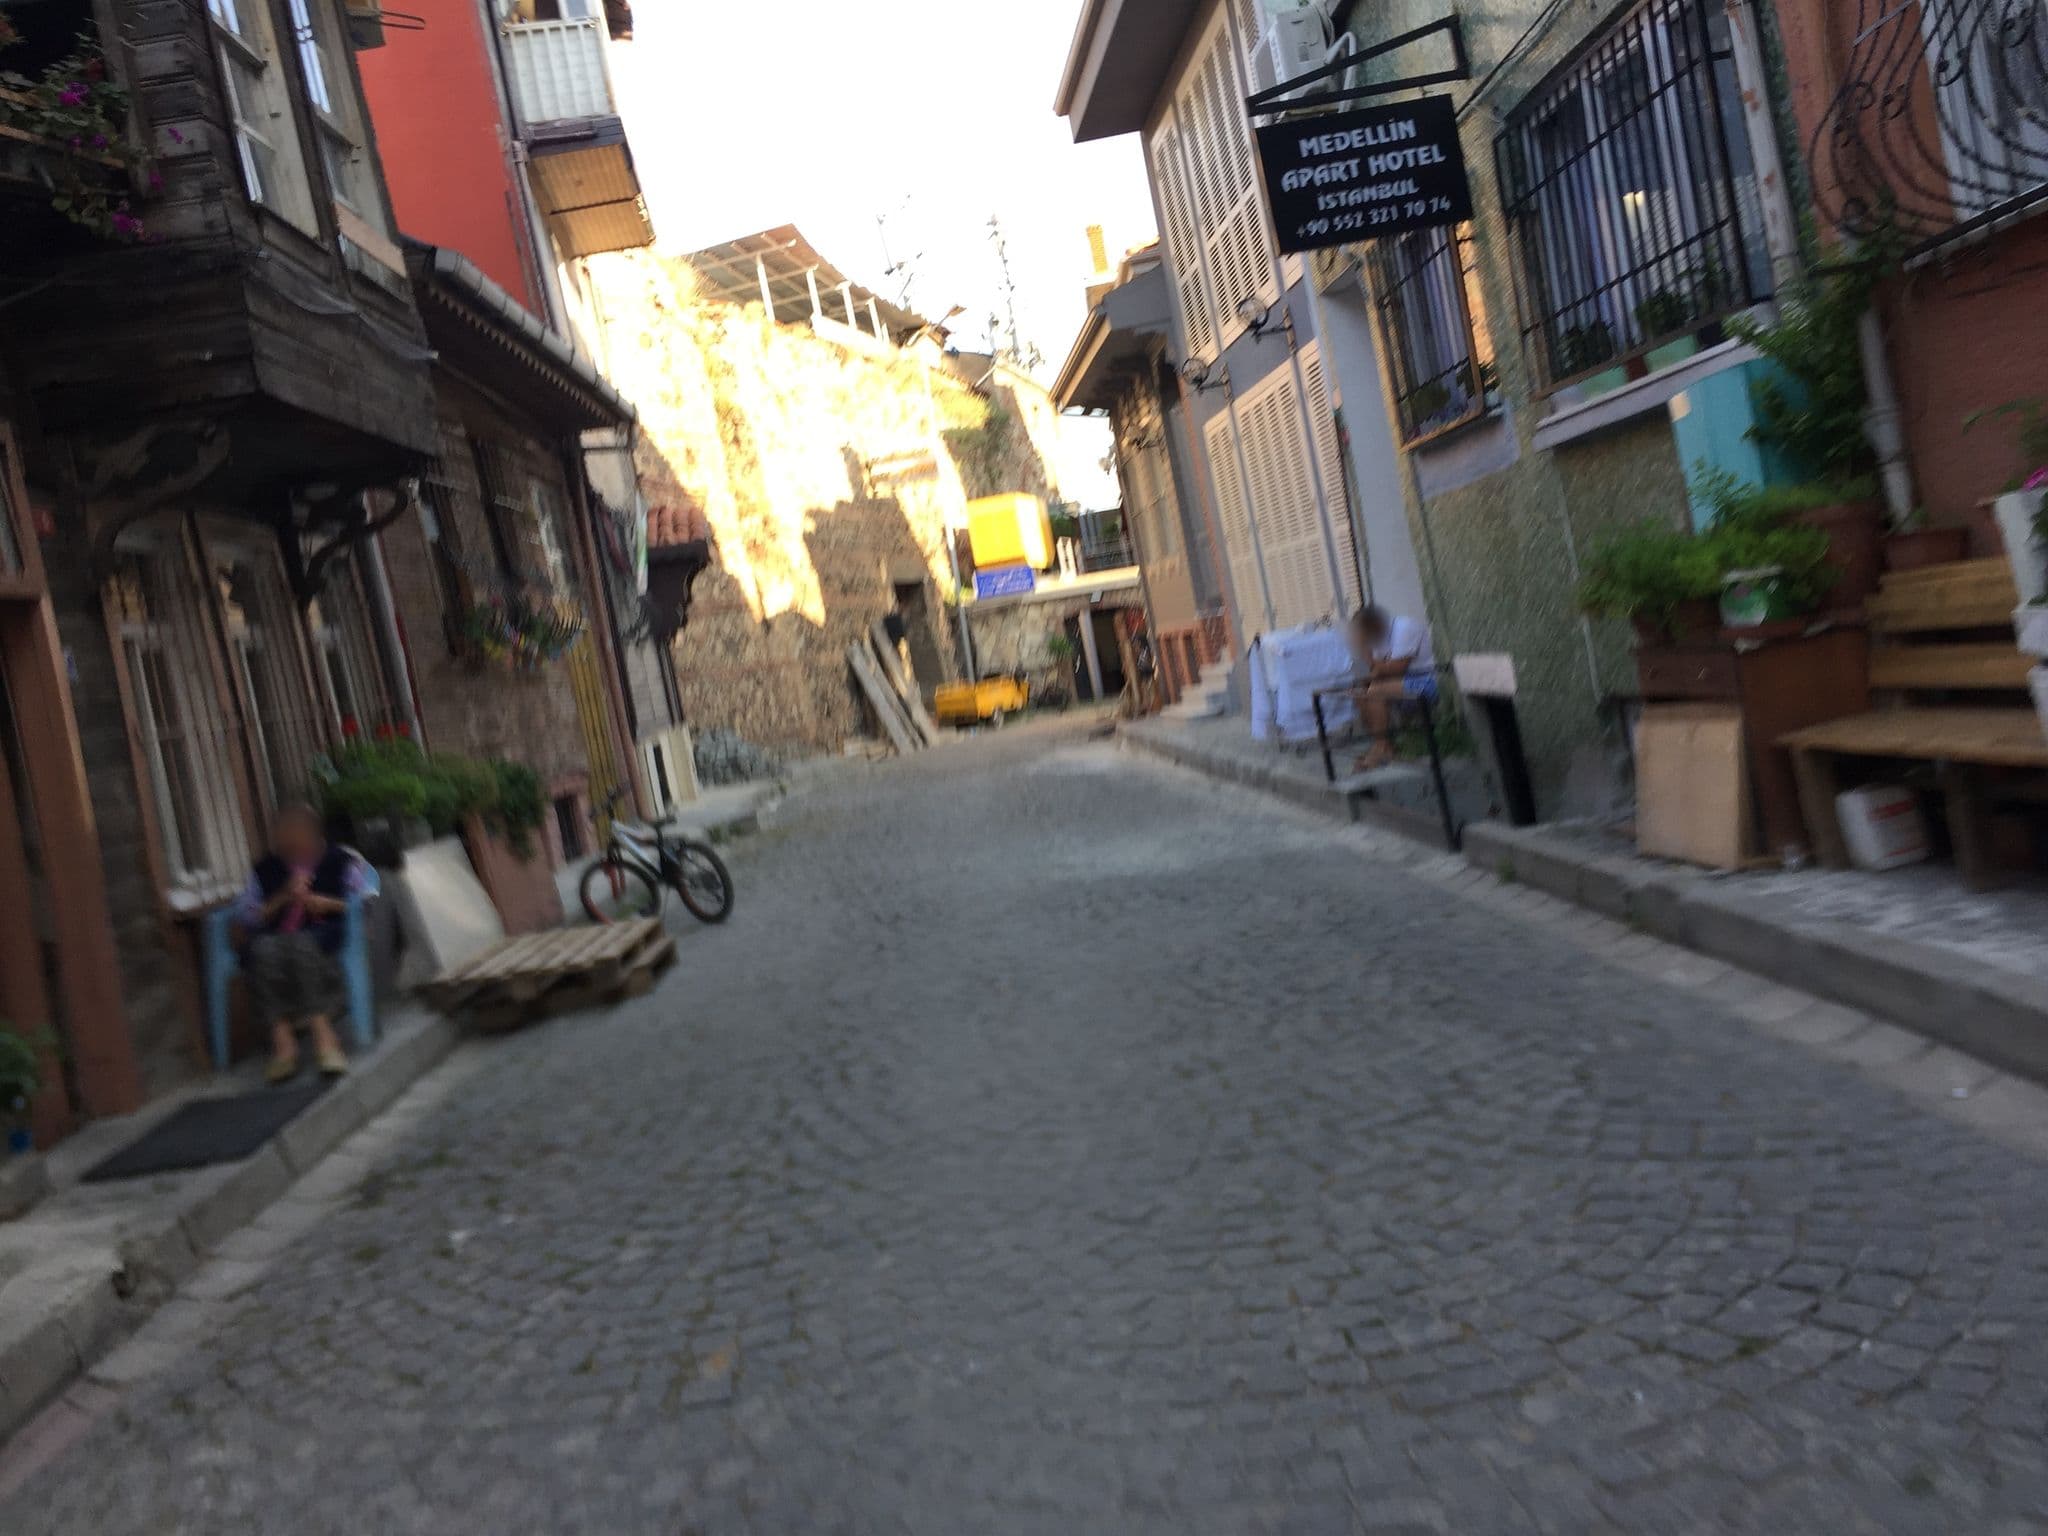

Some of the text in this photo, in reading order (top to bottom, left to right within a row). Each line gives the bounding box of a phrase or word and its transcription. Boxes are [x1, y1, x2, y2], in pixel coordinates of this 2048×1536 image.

[1281, 143, 1446, 193] APART HOTEL
[1295, 217, 1330, 239] +90
